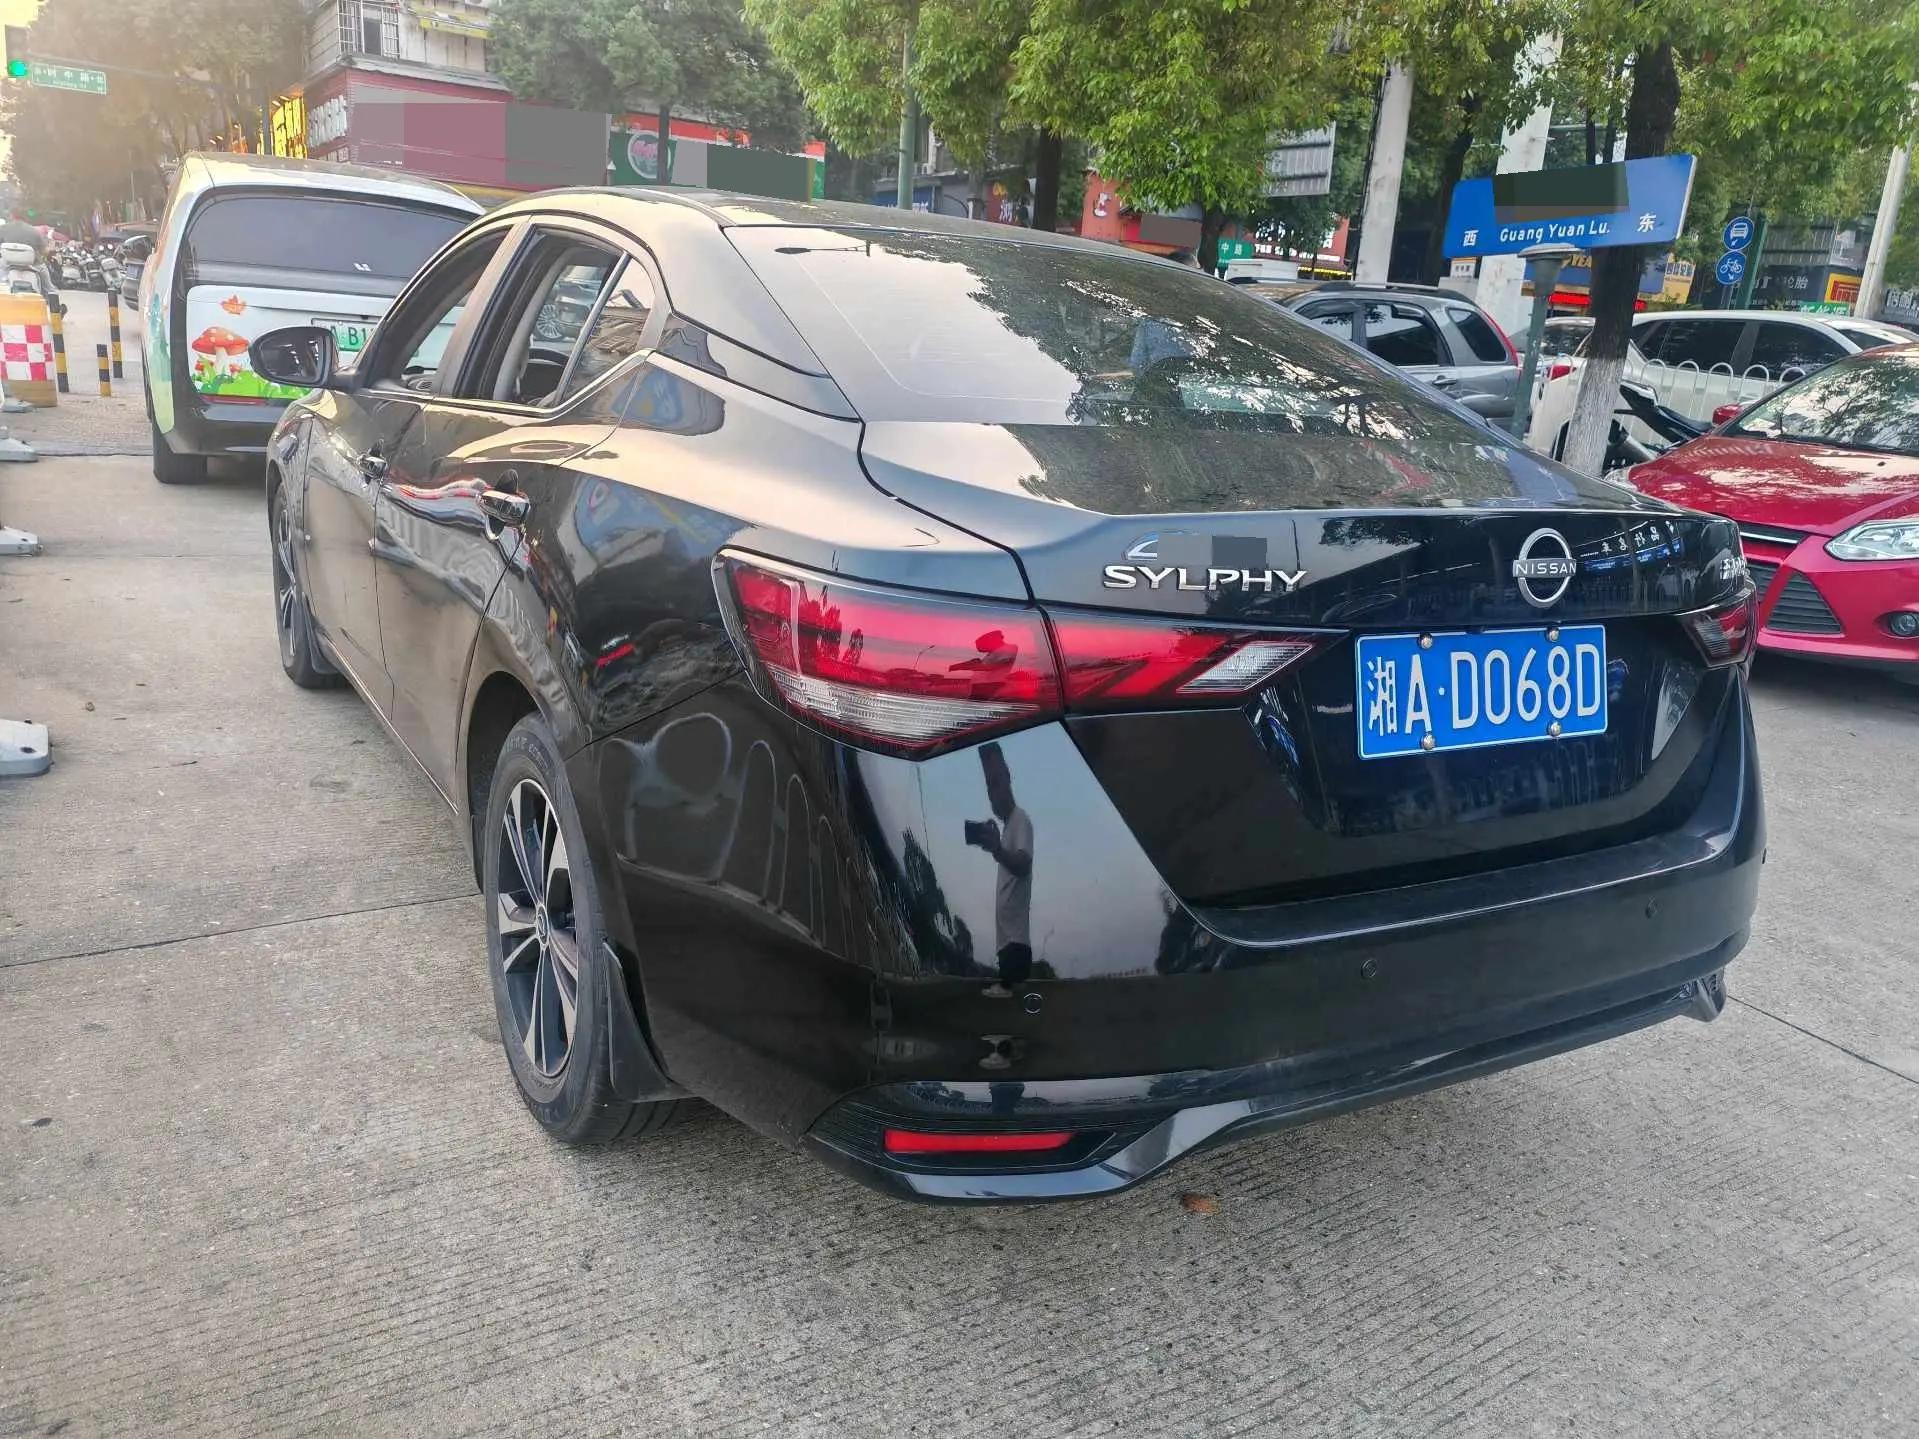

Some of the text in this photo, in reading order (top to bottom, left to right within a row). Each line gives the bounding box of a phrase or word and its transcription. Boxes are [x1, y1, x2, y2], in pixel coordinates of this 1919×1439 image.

[1500, 224, 1543, 244] Guang
[1549, 222, 1585, 238] Yuan
[1637, 212, 1657, 233] 东
[1463, 229, 1480, 247] 西
[1103, 565, 1308, 592] SYLPHY
[1515, 562, 1577, 575] NISSAN
